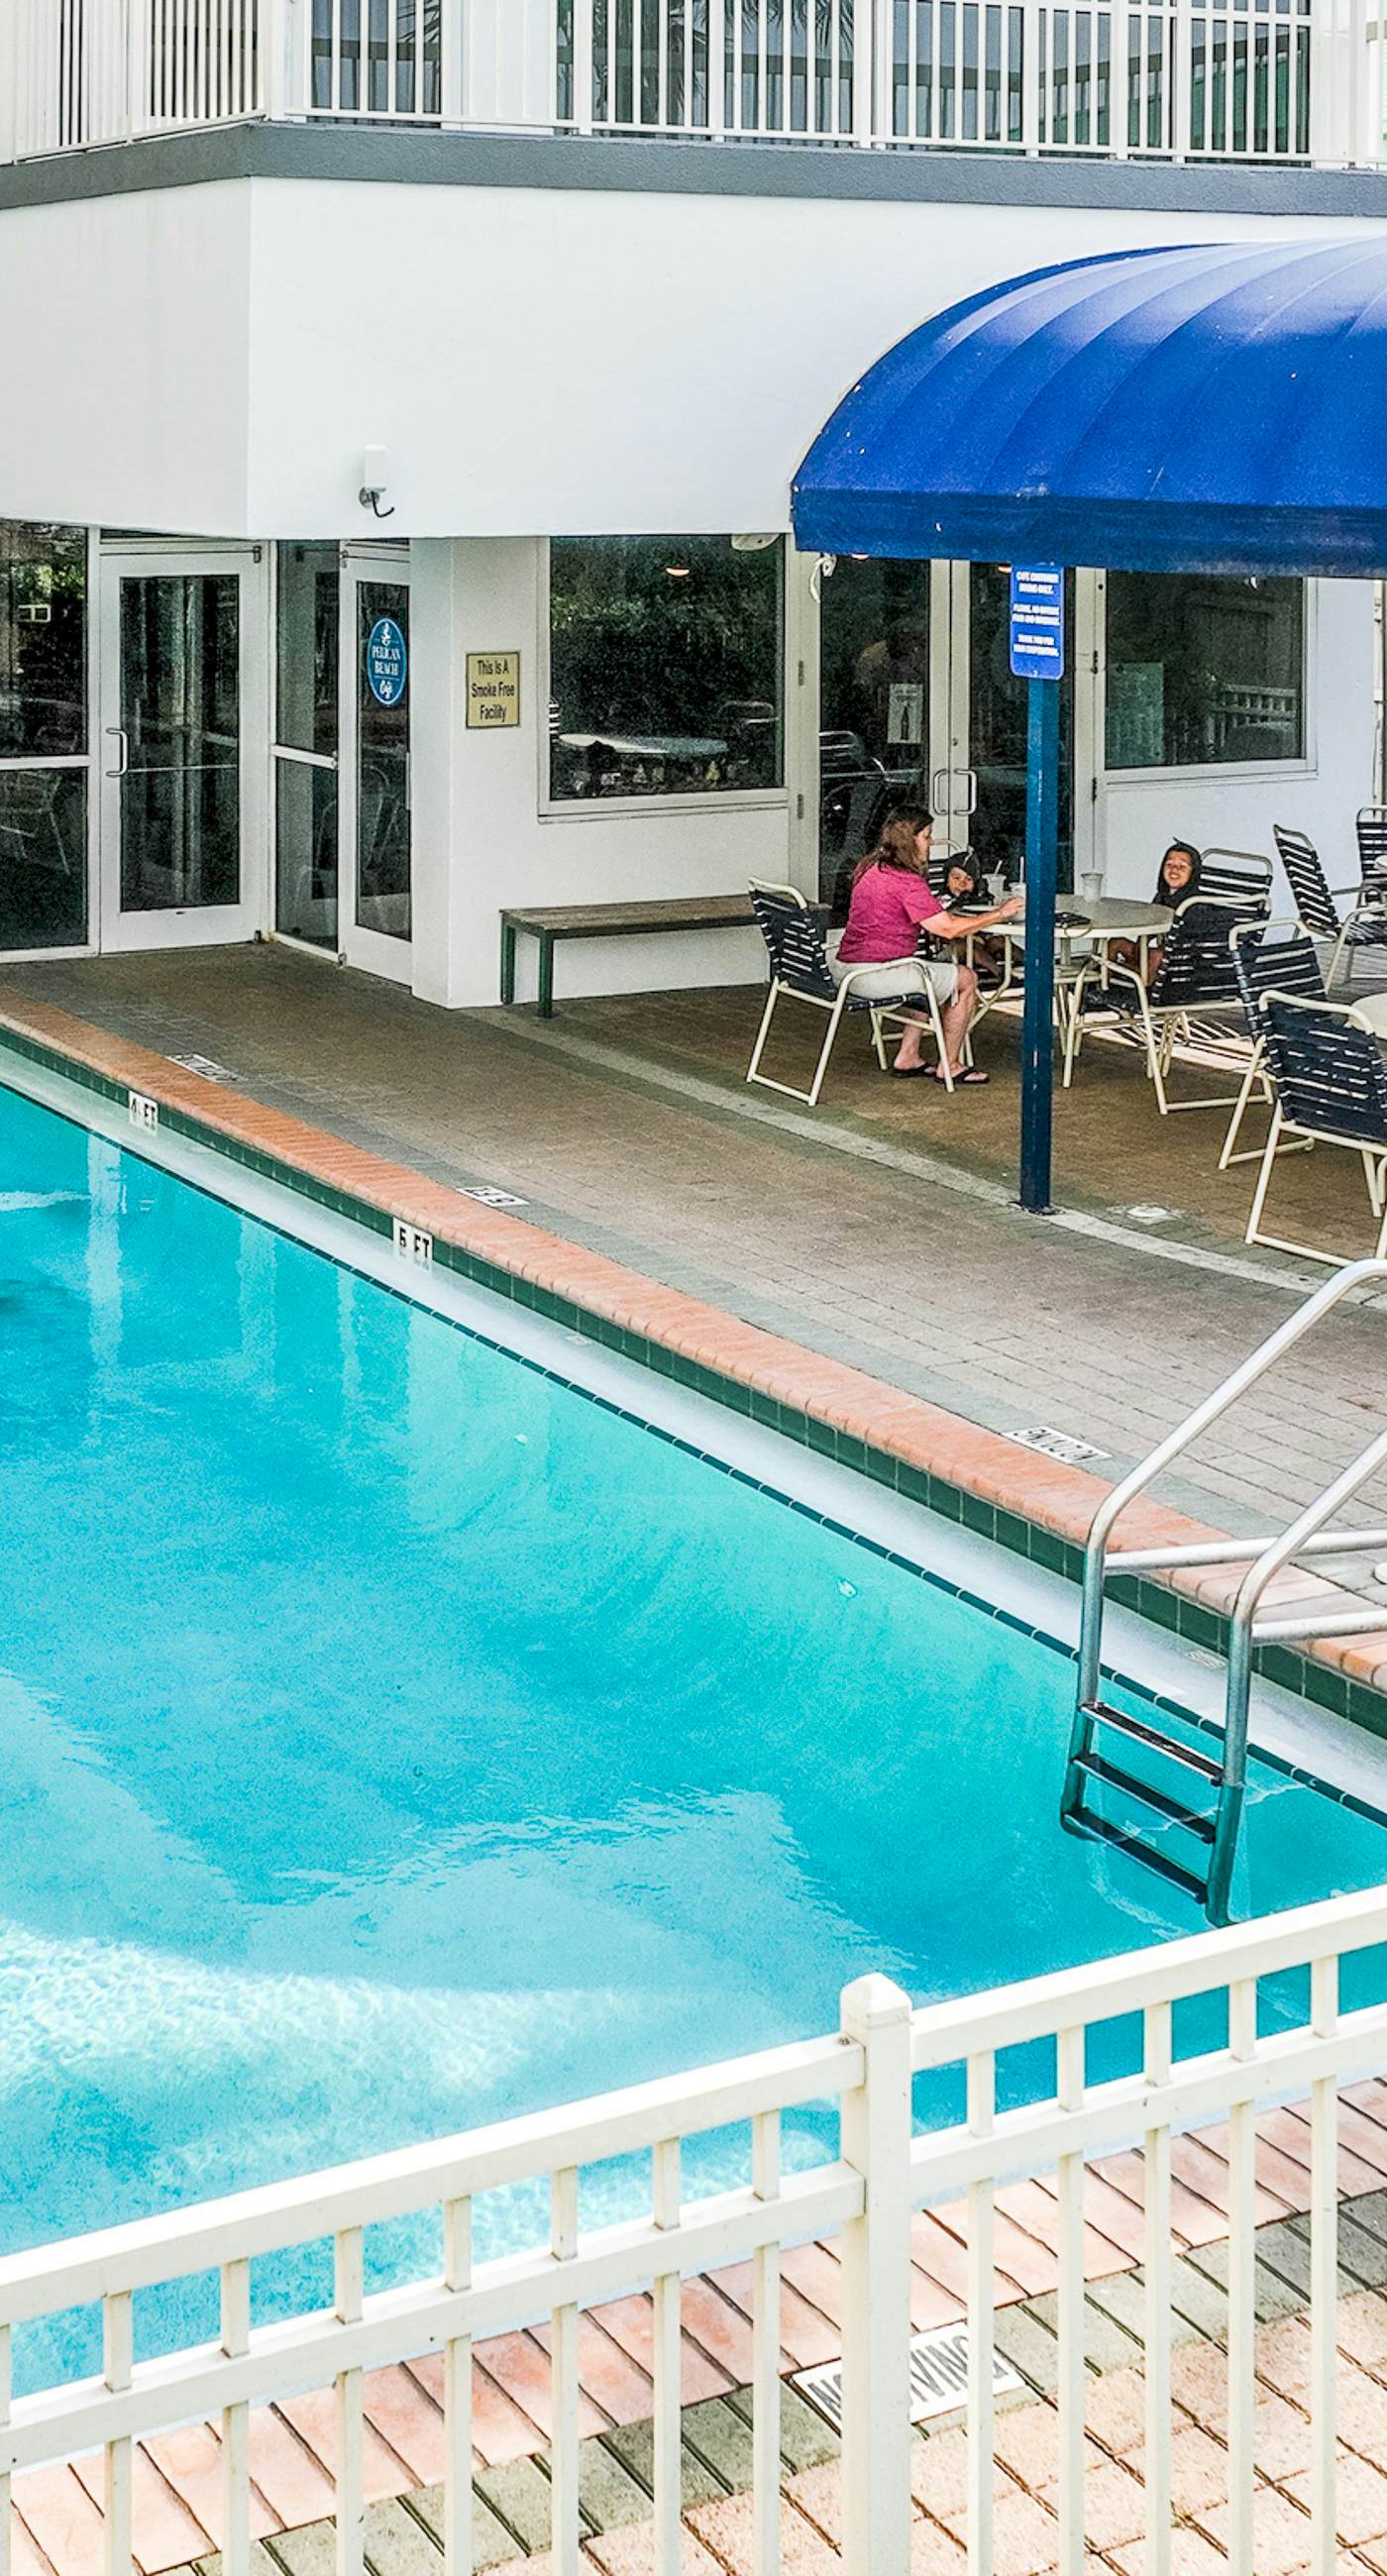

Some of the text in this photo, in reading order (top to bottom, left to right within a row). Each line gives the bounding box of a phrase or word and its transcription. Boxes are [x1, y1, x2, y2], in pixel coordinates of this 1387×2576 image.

[478, 659, 509, 675] This Is A
[472, 681, 515, 698] Smoke Free
[480, 704, 506, 722] Facility
[414, 1234, 429, 1257] FT
